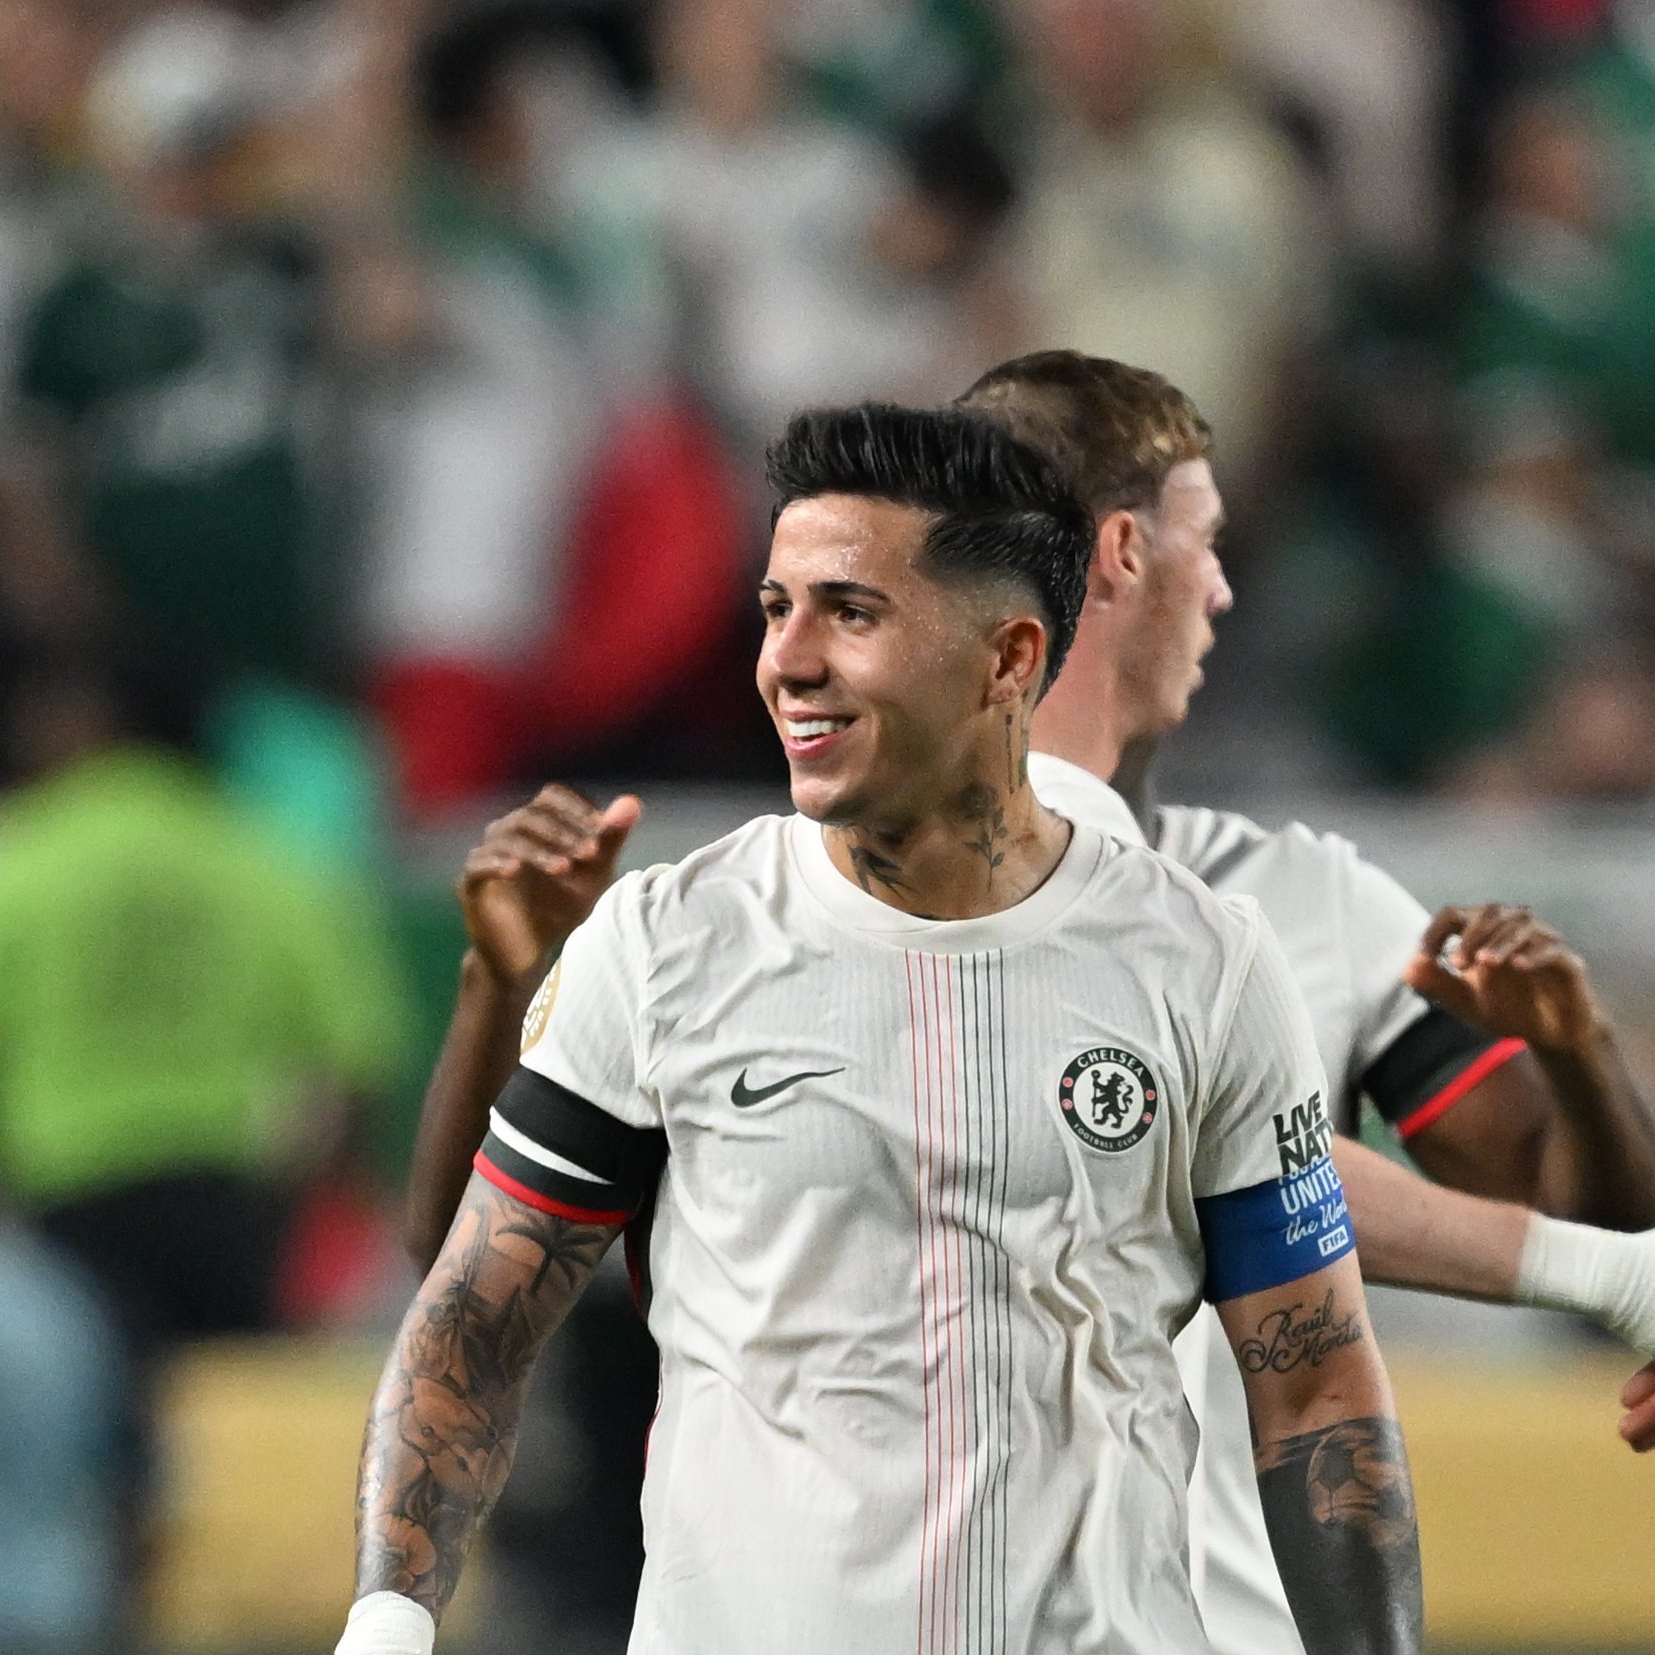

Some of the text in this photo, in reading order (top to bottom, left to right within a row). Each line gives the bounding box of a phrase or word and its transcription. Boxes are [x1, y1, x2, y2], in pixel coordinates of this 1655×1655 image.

[1076, 1049, 1145, 1078] CHELSEA
[1273, 1090, 1323, 1145] LIVE
[1073, 1122, 1138, 1149] FOOTBALL CLUB
[1280, 1158, 1342, 1215] UNITE
[1281, 1214, 1319, 1246] the
[1322, 1230, 1347, 1253] FIFA
